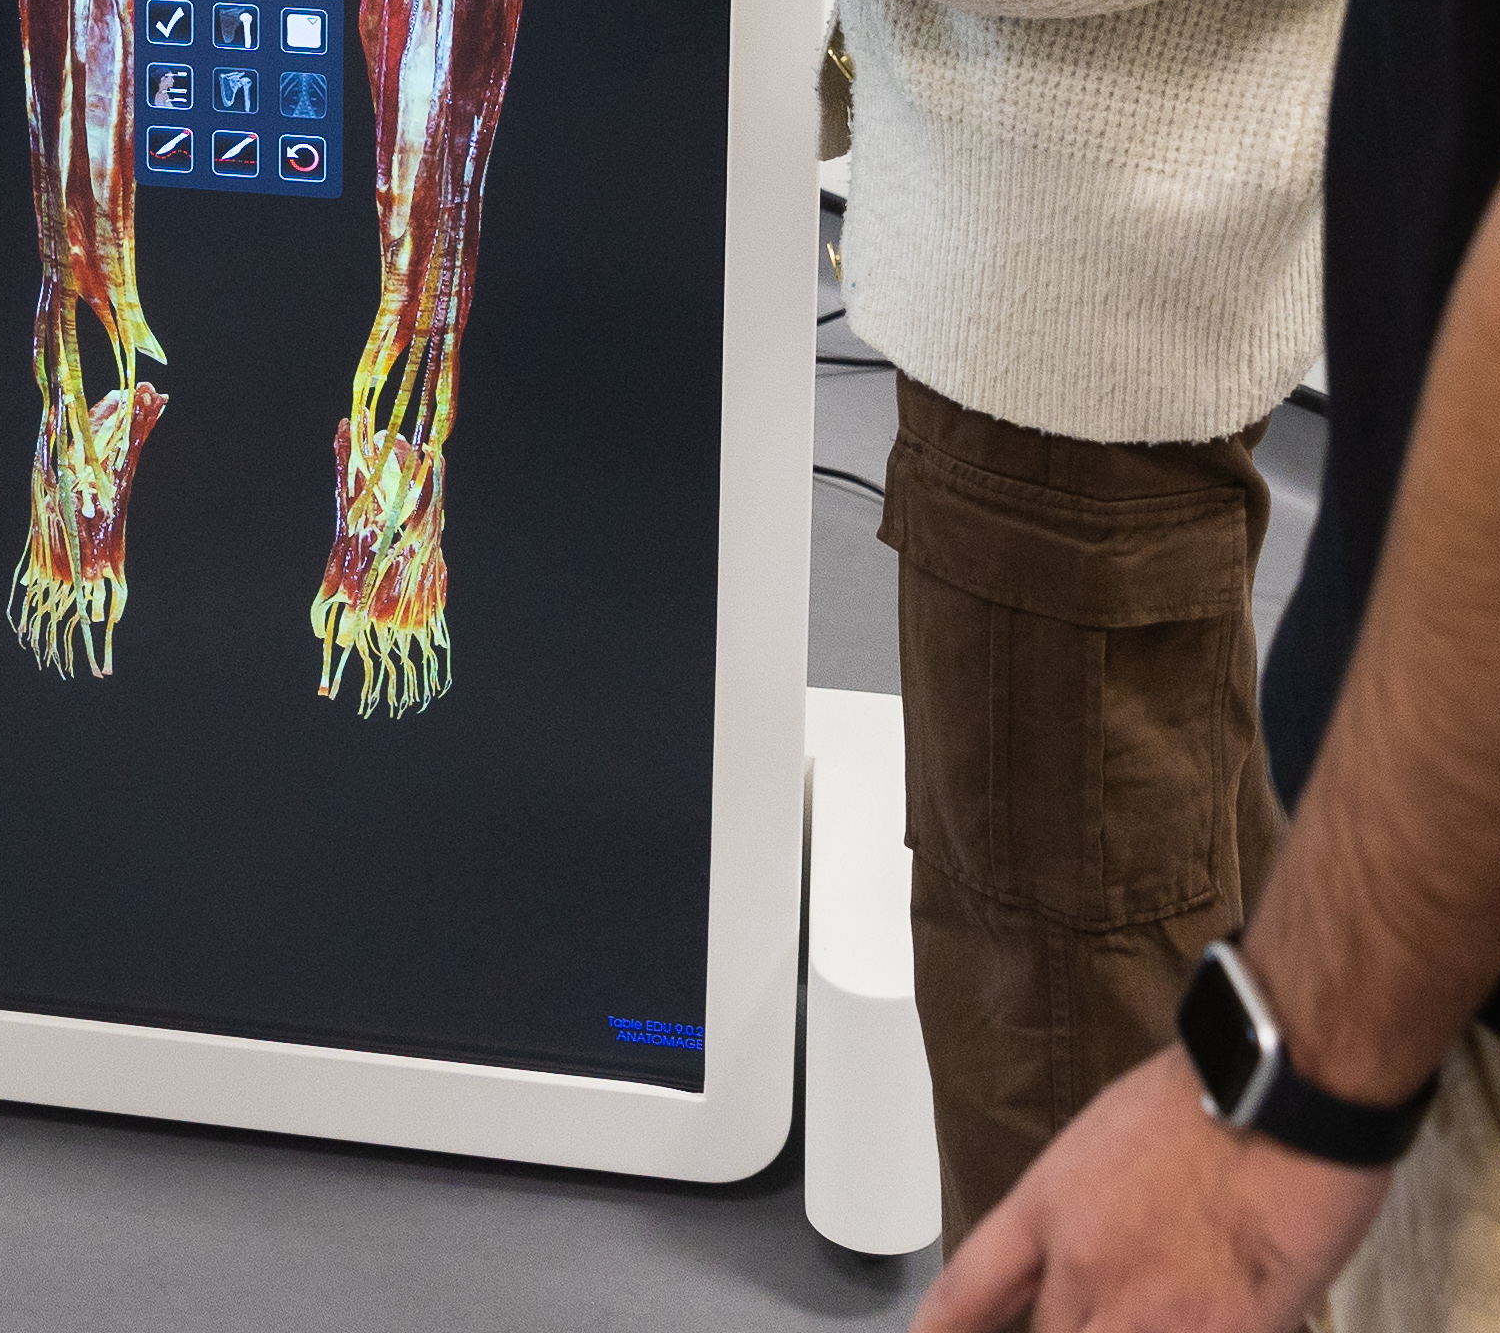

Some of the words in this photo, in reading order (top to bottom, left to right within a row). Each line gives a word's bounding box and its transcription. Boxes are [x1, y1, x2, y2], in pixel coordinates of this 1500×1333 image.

[608, 1015, 643, 1031] Table
[645, 1020, 672, 1034] EDU
[674, 1023, 705, 1038] 9.0.2
[616, 1030, 703, 1051] ANATOMAGE
